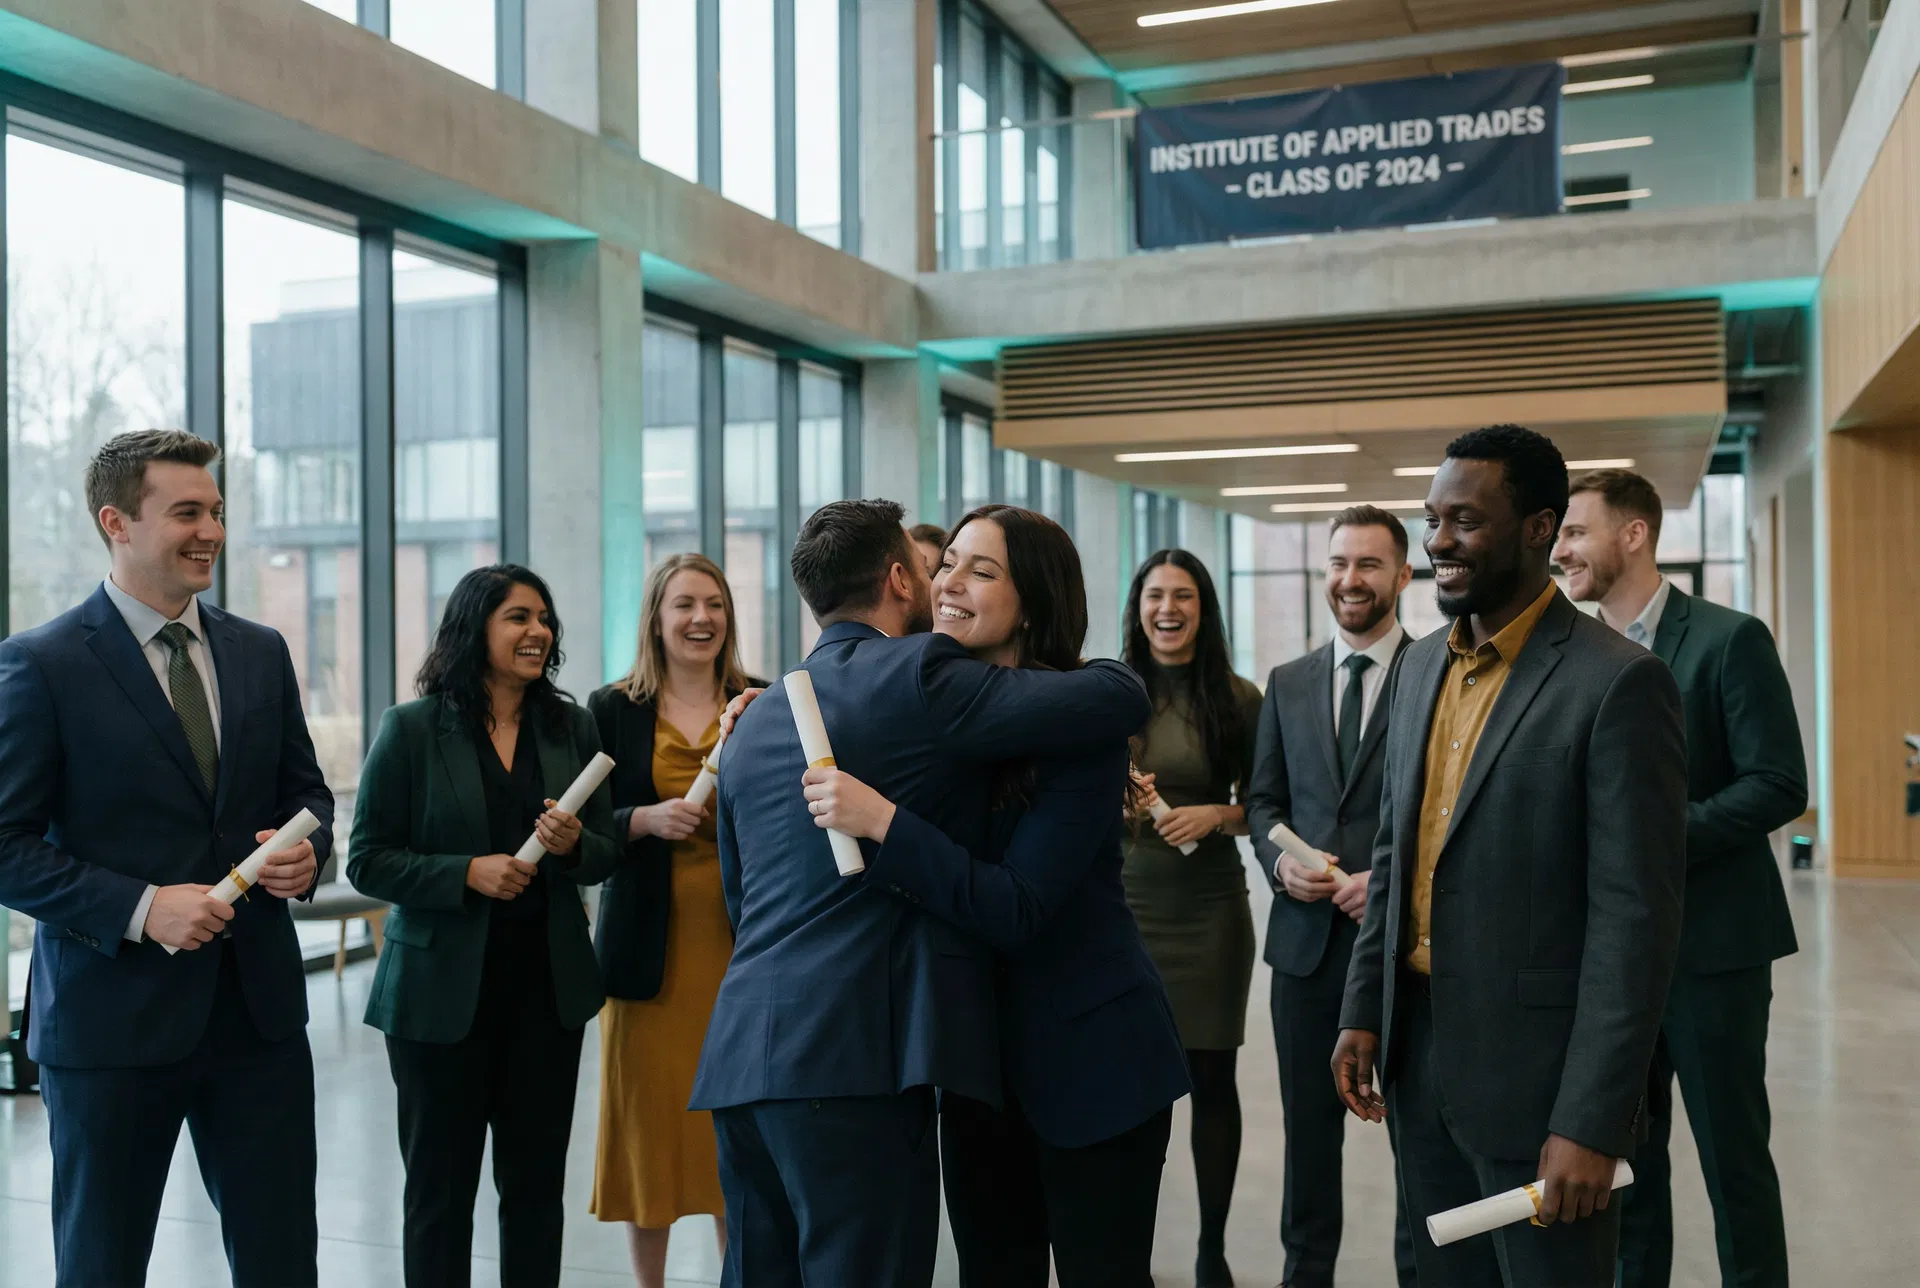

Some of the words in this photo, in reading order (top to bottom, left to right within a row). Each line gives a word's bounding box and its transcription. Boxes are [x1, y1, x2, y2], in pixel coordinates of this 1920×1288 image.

[1150, 134, 1279, 173] INSTITUTE
[1283, 130, 1318, 159] OF
[1321, 119, 1433, 155] APPLIED
[1437, 106, 1545, 142] TRADES
[1246, 166, 1331, 199] CLASS
[1335, 162, 1370, 191] OF
[1375, 155, 1441, 187] 2024
